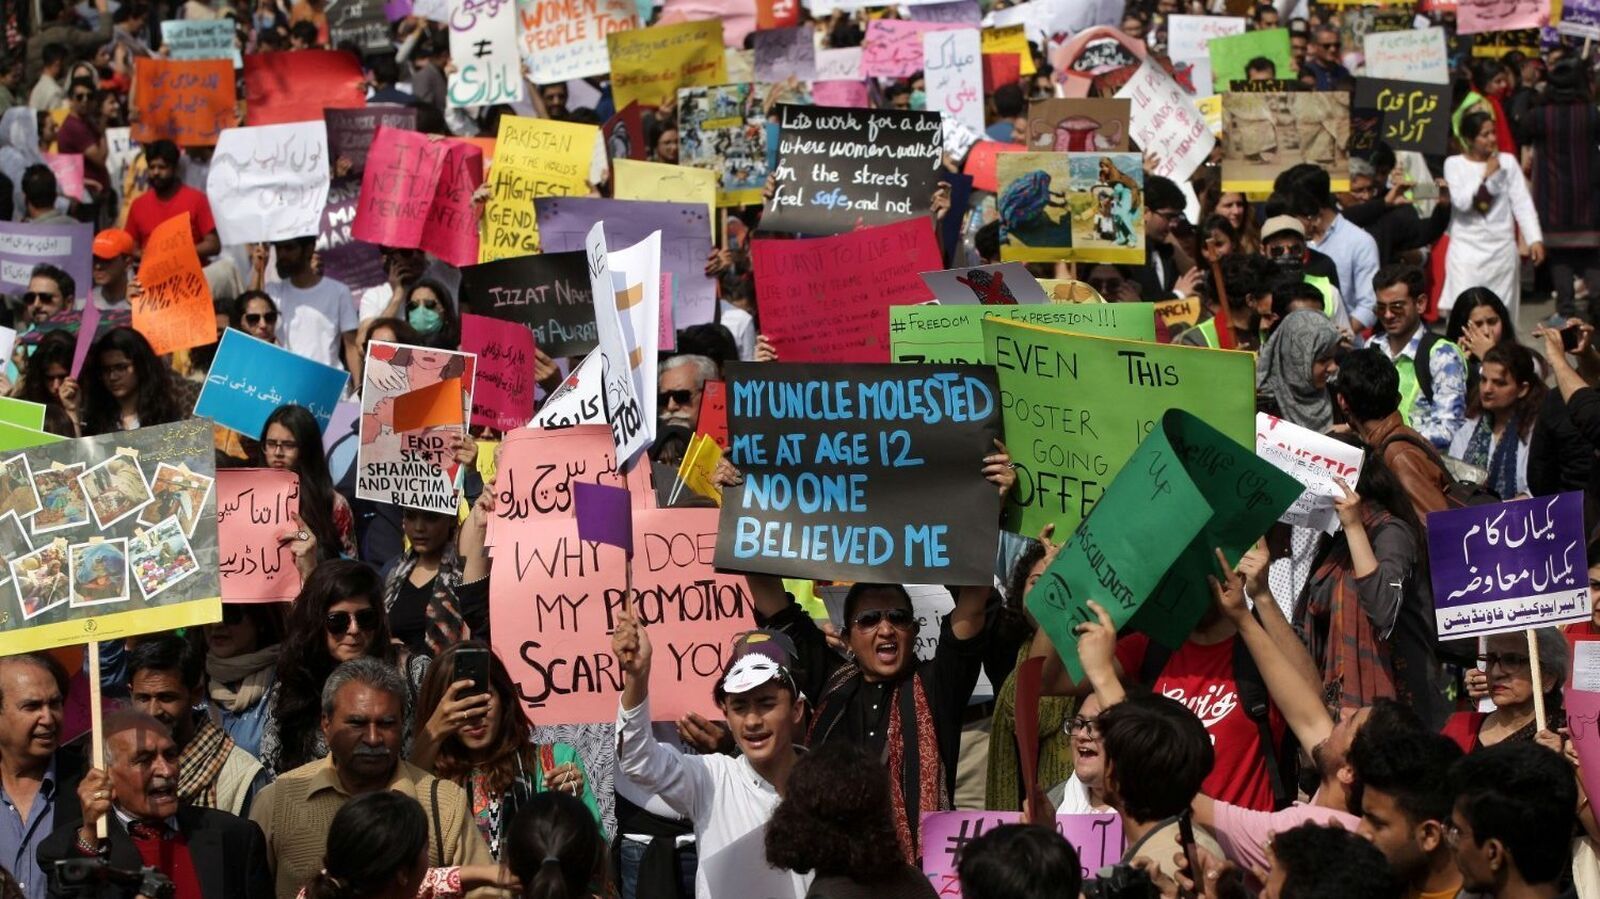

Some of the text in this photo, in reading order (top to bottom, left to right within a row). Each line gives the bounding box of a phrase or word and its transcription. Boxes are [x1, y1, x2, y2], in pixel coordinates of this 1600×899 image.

[524, 21, 587, 54] PEOPLE
[448, 60, 517, 105] بازاری
[1377, 89, 1439, 121] قدم قدم
[503, 126, 573, 153] PAKISTAN
[779, 135, 826, 156] where
[828, 140, 895, 159] women
[816, 112, 862, 131] work
[867, 113, 897, 142] for
[900, 116, 912, 129] a
[915, 113, 943, 146] day
[1386, 117, 1432, 143] آزاد
[494, 170, 571, 201] HIGHEST
[811, 163, 841, 183] the
[851, 164, 909, 188] streets
[770, 184, 805, 213] feel
[854, 191, 881, 211] and
[884, 196, 913, 215] not
[488, 204, 539, 233] GEND
[493, 228, 520, 249] PAY
[771, 246, 828, 275] WANT
[830, 244, 855, 267] TO
[858, 237, 889, 263] LIVE
[897, 229, 920, 250] MY
[488, 284, 551, 308] IZZAT
[996, 335, 1180, 387] EVEN THIS
[733, 372, 994, 425] MY UNCLE MOLESTED
[999, 389, 1099, 440] POSTER
[407, 434, 444, 450] END
[732, 429, 925, 468] ME AT AGE 12
[1032, 438, 1109, 476] GOING
[358, 477, 445, 493] AND VICTIM
[367, 463, 442, 478] SHAMING
[531, 459, 586, 514] سوچ
[250, 492, 282, 525] اتنا
[390, 491, 458, 510] BLAMING
[497, 467, 529, 523] بدلو
[742, 472, 868, 513] NO ONE
[1010, 463, 1106, 519] OFFE
[733, 516, 951, 568] BELIEVED ME
[1462, 494, 1560, 566] یکساں کام
[515, 532, 718, 583] WHY DOE
[1076, 524, 1138, 612] ASCULINITY
[1446, 540, 1577, 601] یکساں معاوضہ
[536, 592, 589, 633] MY
[1507, 599, 1558, 622] ایجوکیشن
[518, 640, 626, 703] SCAR
